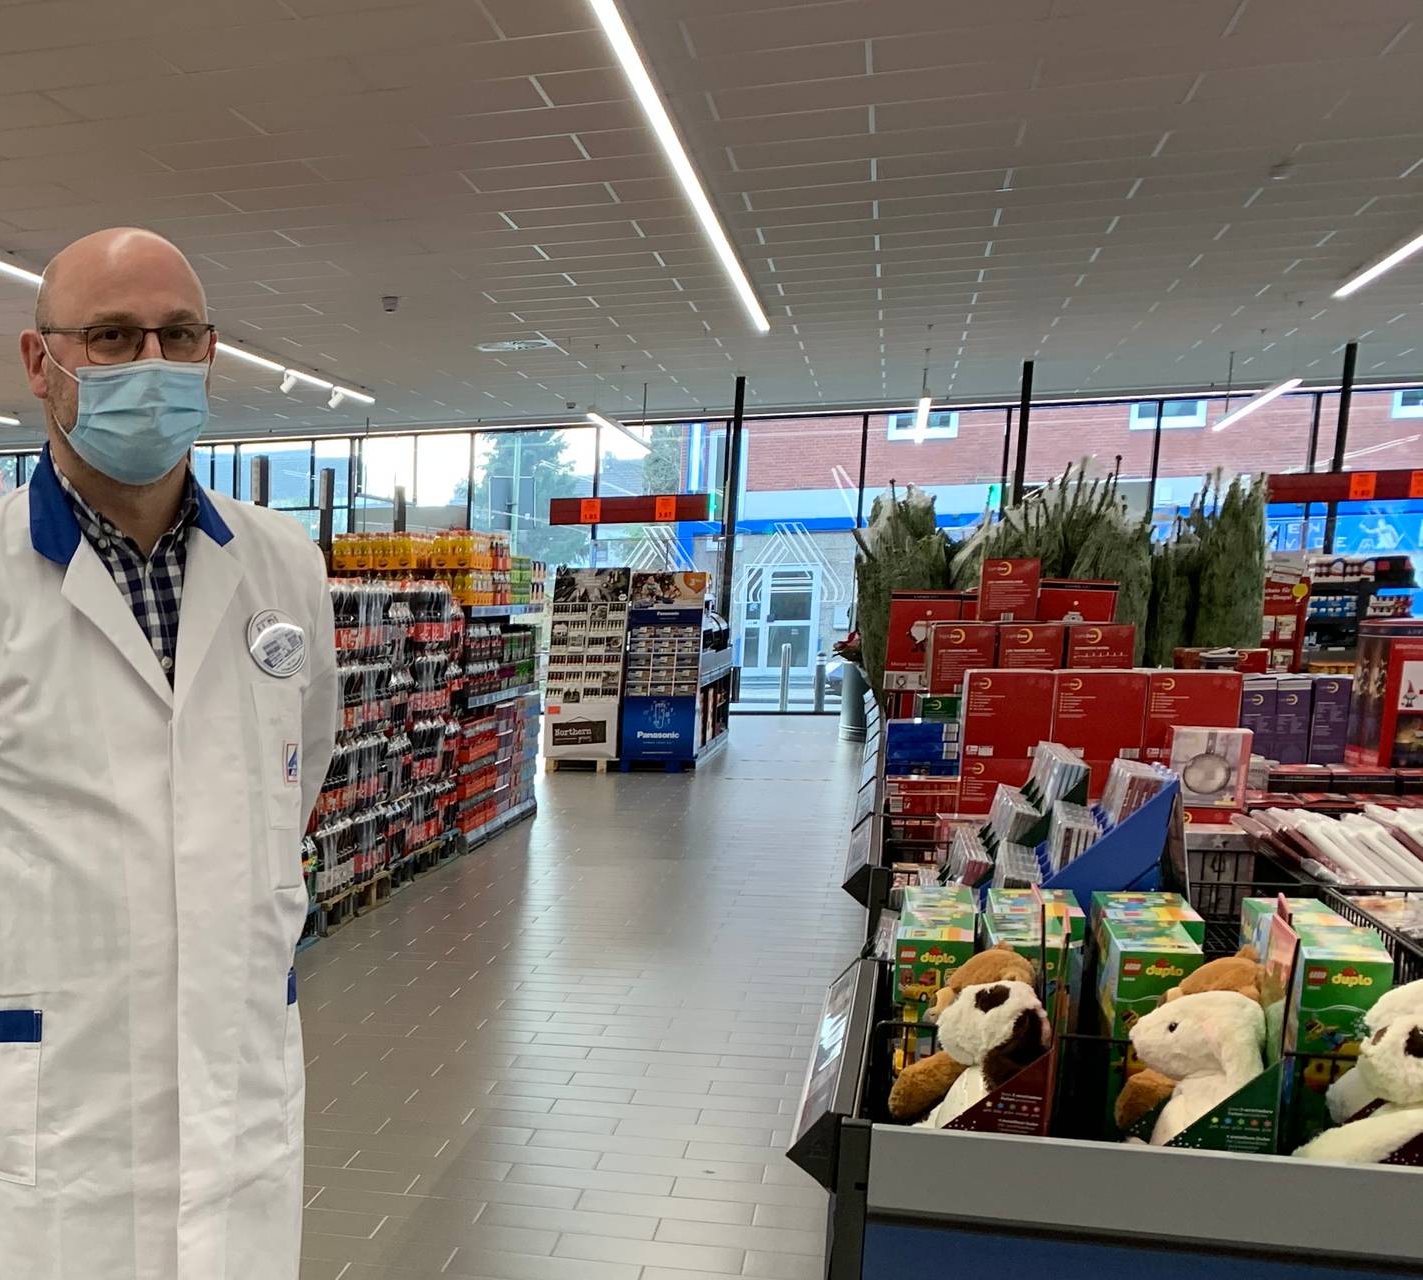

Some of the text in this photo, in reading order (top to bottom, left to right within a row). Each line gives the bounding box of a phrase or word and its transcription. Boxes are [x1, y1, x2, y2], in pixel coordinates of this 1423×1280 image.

[554, 728, 593, 736] Northern
[637, 731, 680, 739] Panasonic
[920, 953, 956, 965] duplo
[1145, 964, 1184, 977] duplo
[1332, 973, 1373, 987] duplo
